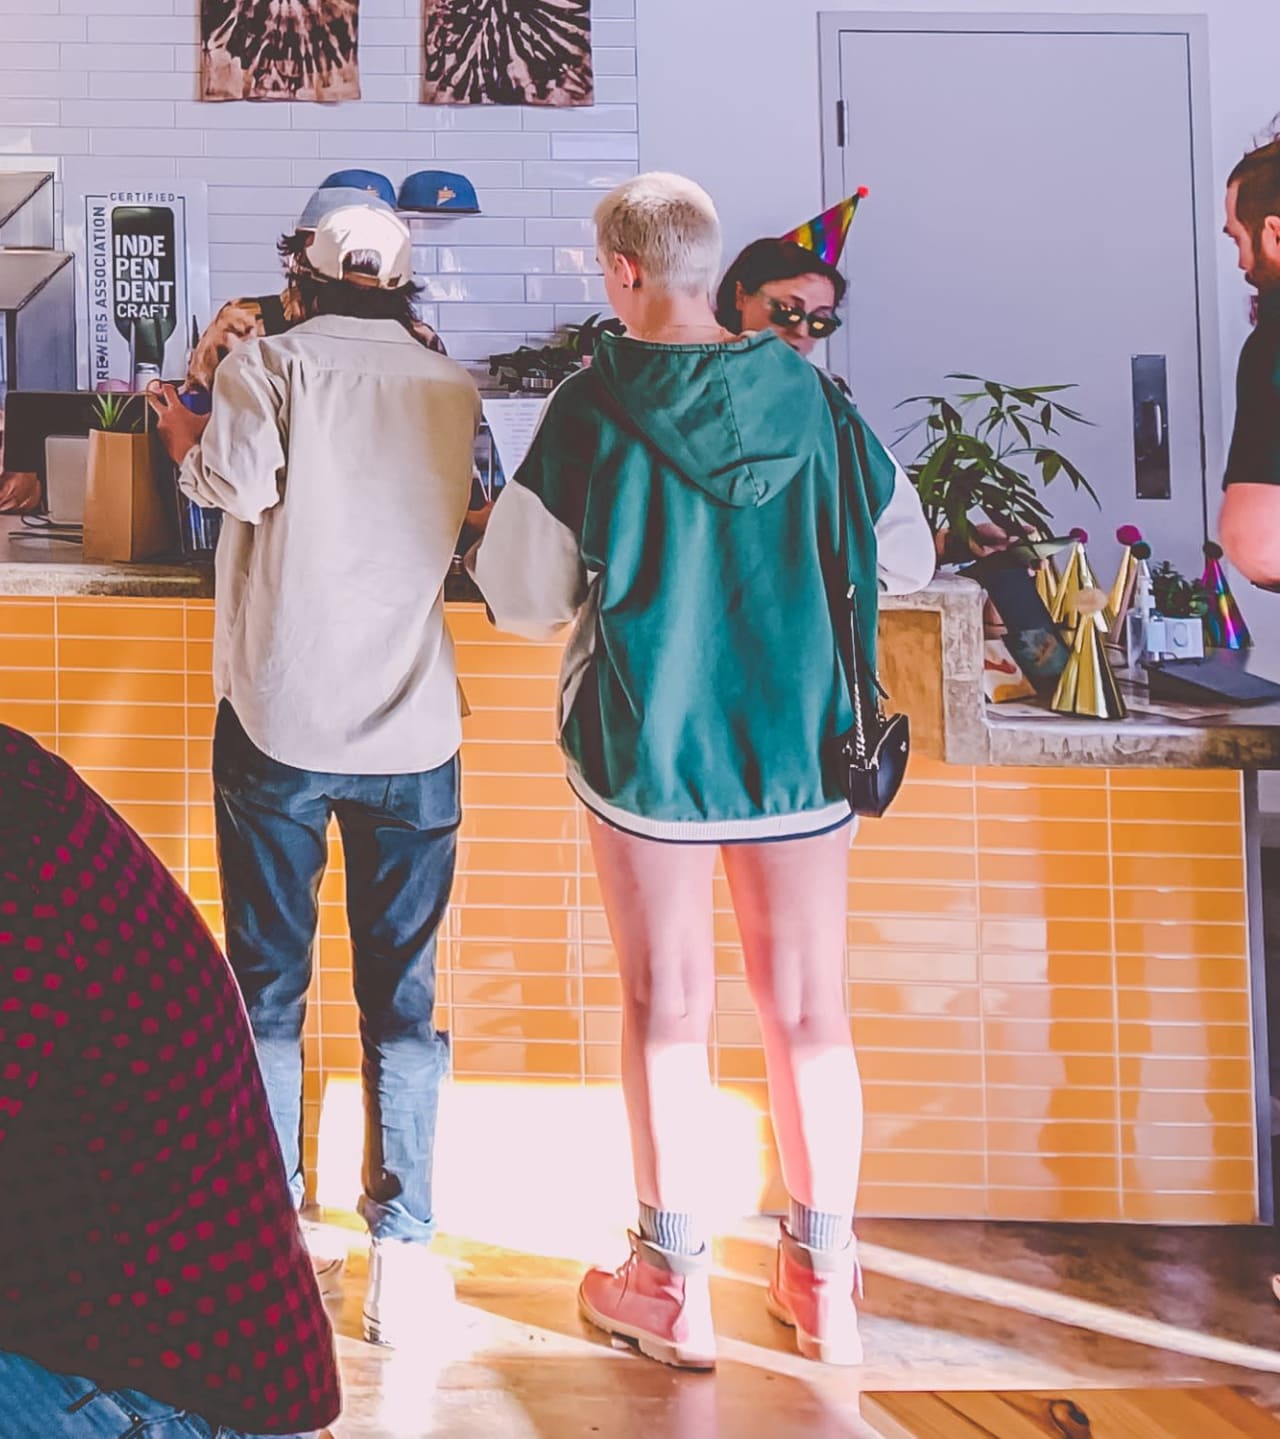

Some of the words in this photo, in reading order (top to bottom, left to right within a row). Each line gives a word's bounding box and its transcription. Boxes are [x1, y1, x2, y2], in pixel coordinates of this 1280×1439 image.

[109, 192, 175, 203] CERTIFIED
[93, 206, 108, 308] ASSOCIATION
[114, 234, 166, 257] INDE
[115, 258, 160, 280] PEN
[115, 280, 174, 303] DENT
[116, 303, 170, 319] CRAFT
[95, 313, 109, 380] REWERS
